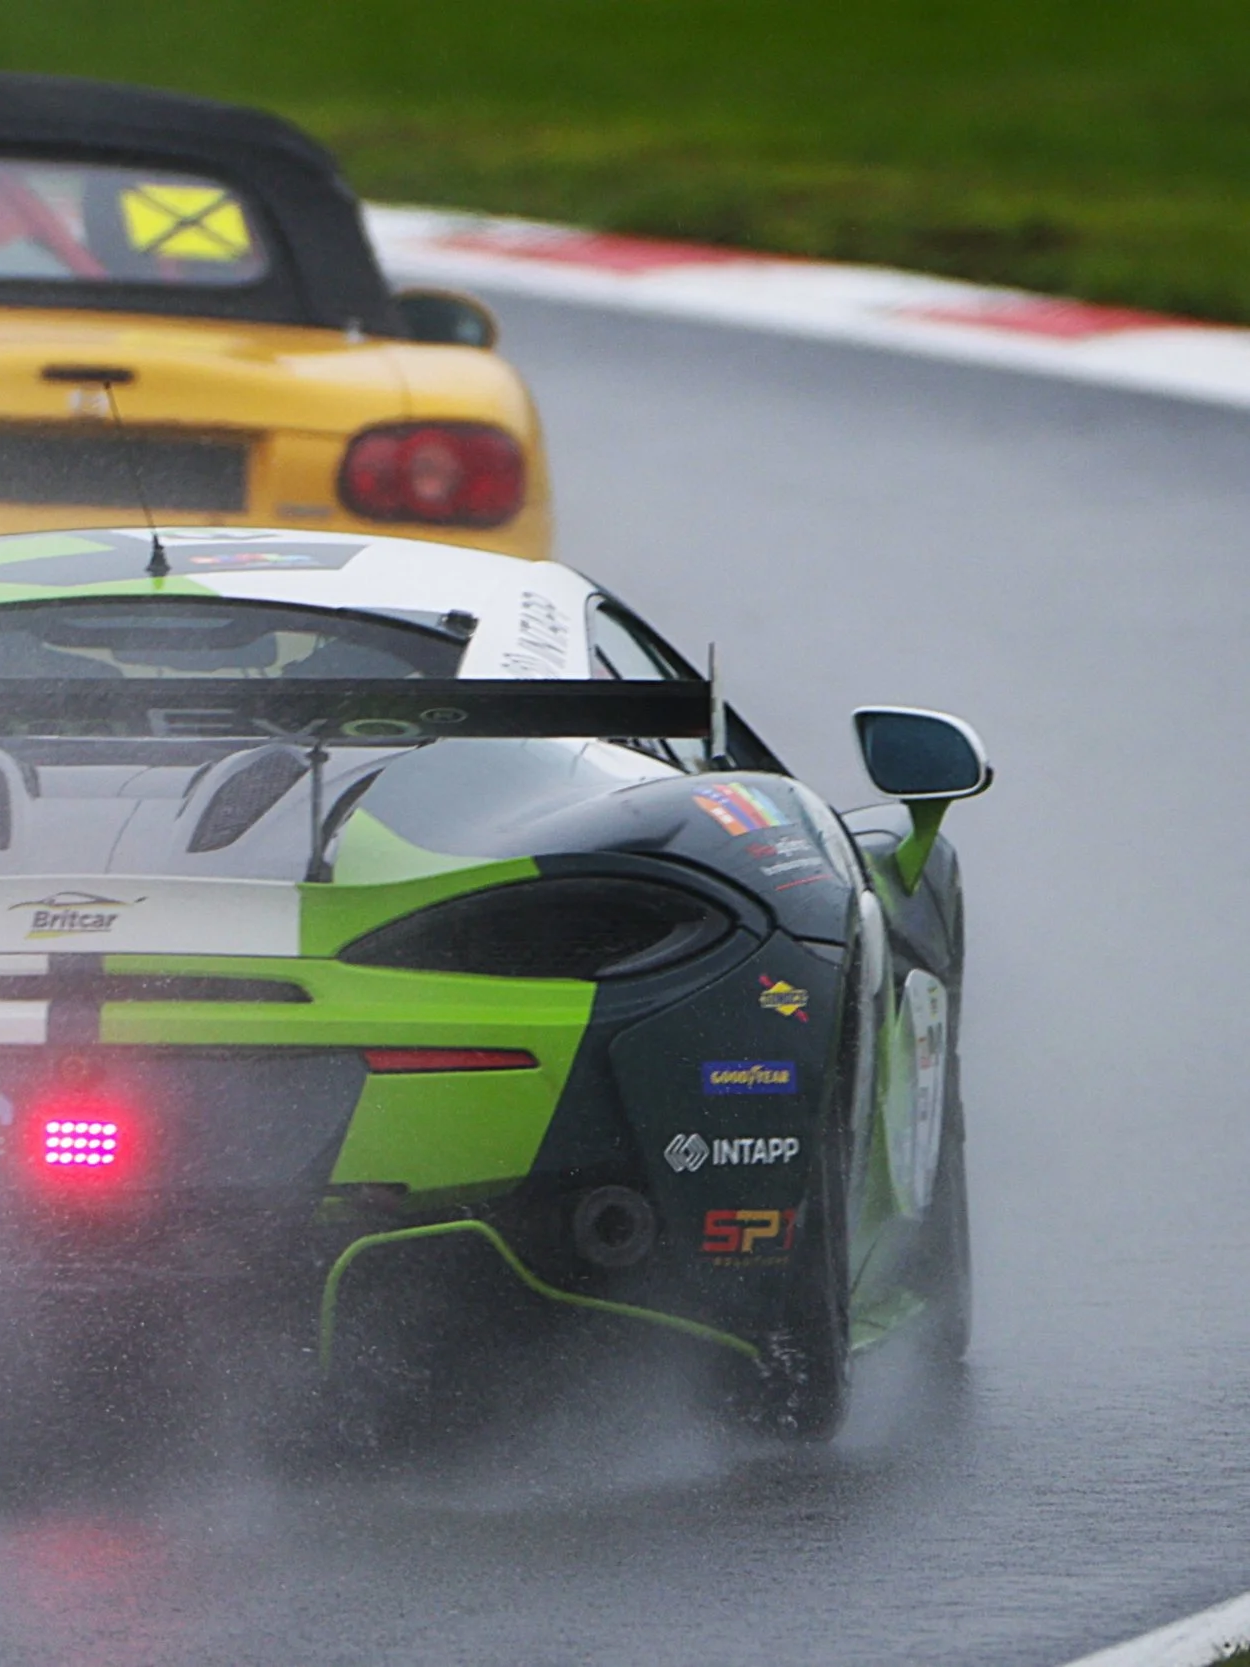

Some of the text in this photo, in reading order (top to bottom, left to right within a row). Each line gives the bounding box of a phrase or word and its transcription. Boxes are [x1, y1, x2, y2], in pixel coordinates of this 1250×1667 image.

[33, 909, 119, 929] Britcar
[710, 1064, 790, 1089] GOODYEAR
[712, 1137, 799, 1165] INTAPP
[702, 1208, 796, 1252] SP1
